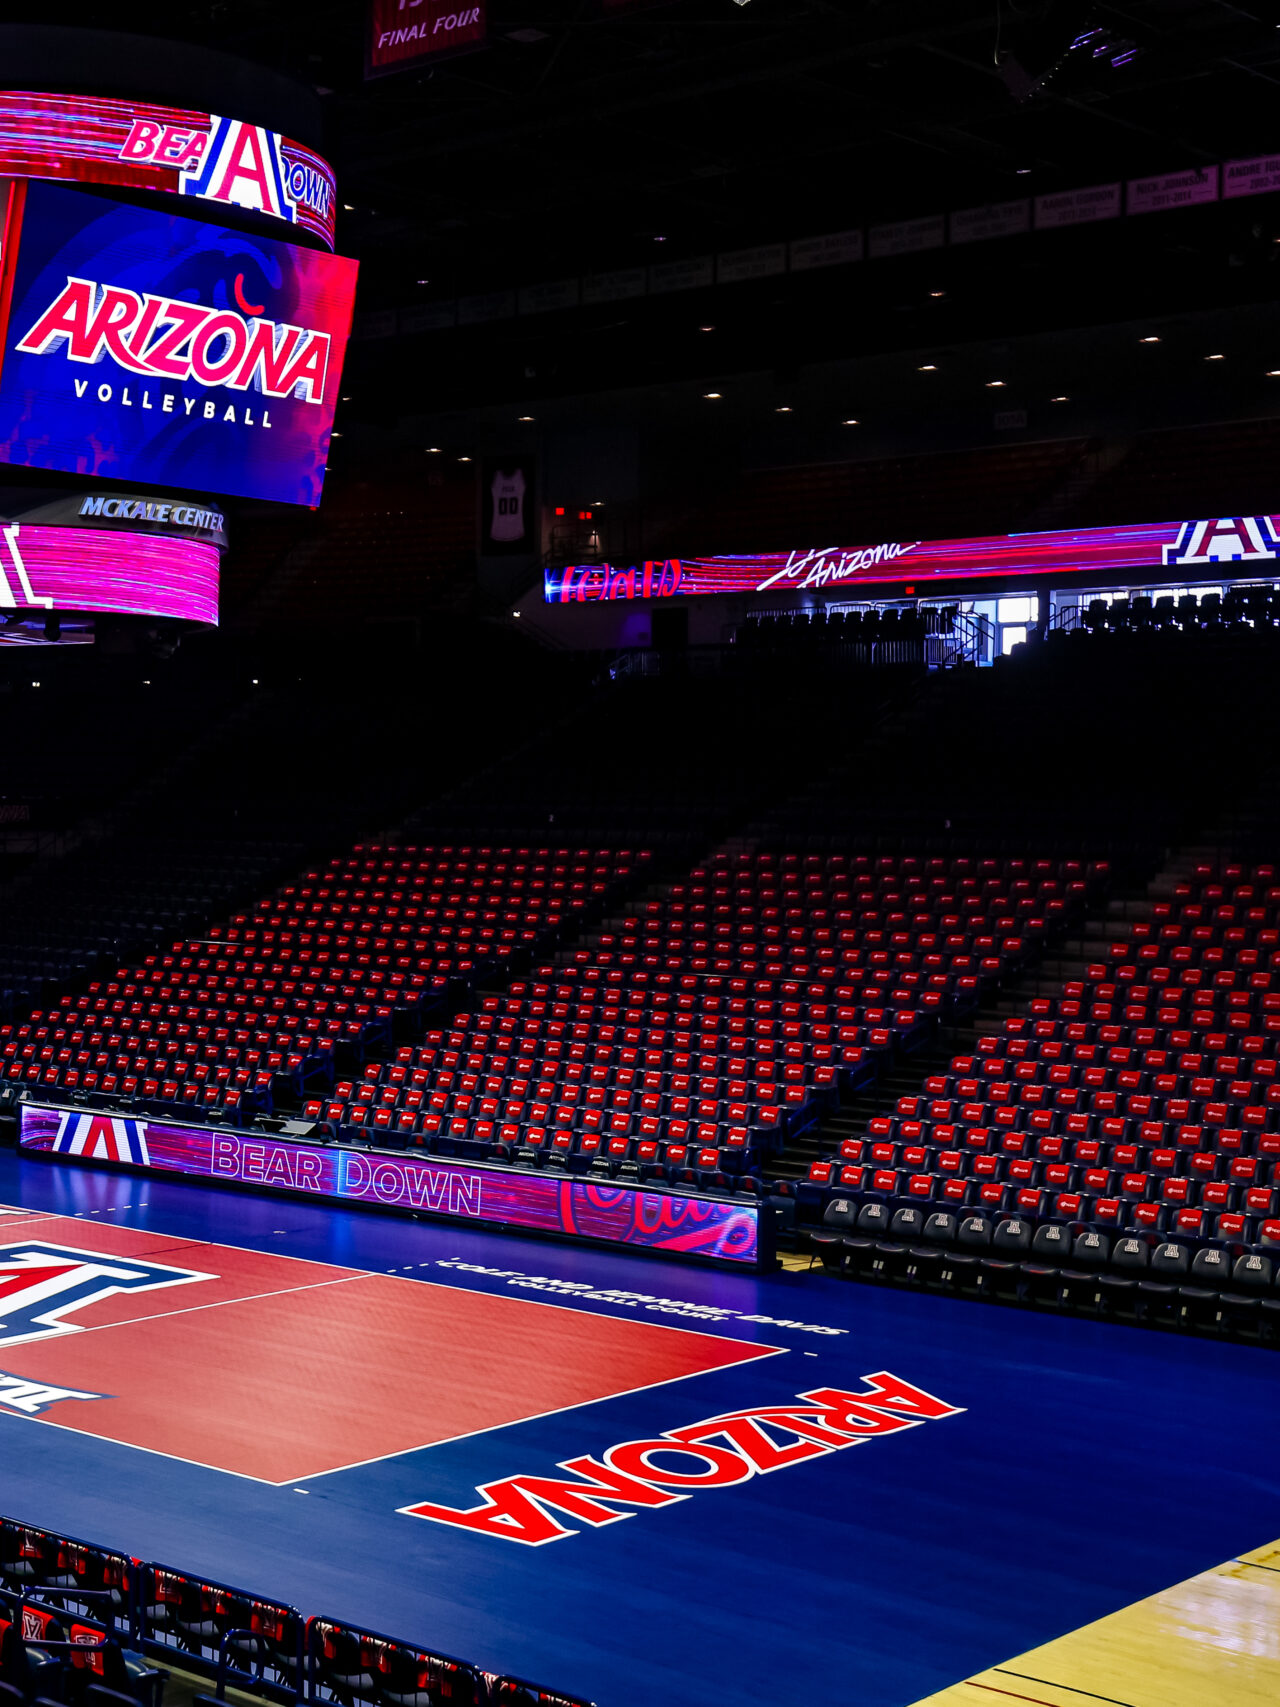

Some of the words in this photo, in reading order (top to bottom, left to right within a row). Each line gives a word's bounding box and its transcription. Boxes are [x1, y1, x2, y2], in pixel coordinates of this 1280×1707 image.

[378, 22, 427, 48] FINAL
[433, 7, 480, 34] FOUR
[118, 118, 209, 171] BEA
[179, 114, 297, 224] A
[1137, 181, 1159, 195] NICK
[1163, 173, 1208, 191] JOHNSON
[1228, 163, 1261, 179] ANDRE
[1042, 194, 1073, 210] AARON
[1076, 190, 1114, 204] GORDON
[15, 276, 331, 405] ARIZONA
[75, 378, 271, 428] VOLLEYBALL
[79, 496, 172, 523] MCKALE
[173, 506, 224, 532] CENTER
[499, 497, 518, 515] 00
[796, 541, 921, 588] Arizona
[211, 1132, 321, 1191] BEAR
[336, 1151, 480, 1216] DOWN
[437, 1260, 525, 1277] COLE
[513, 1275, 594, 1291] AND
[588, 1289, 742, 1316] JEANNIE
[735, 1314, 849, 1335] DAVIS
[507, 1279, 638, 1307] VOLLEYBALL
[645, 1304, 729, 1321] COURT
[395, 1370, 968, 1547] ARIZONA
